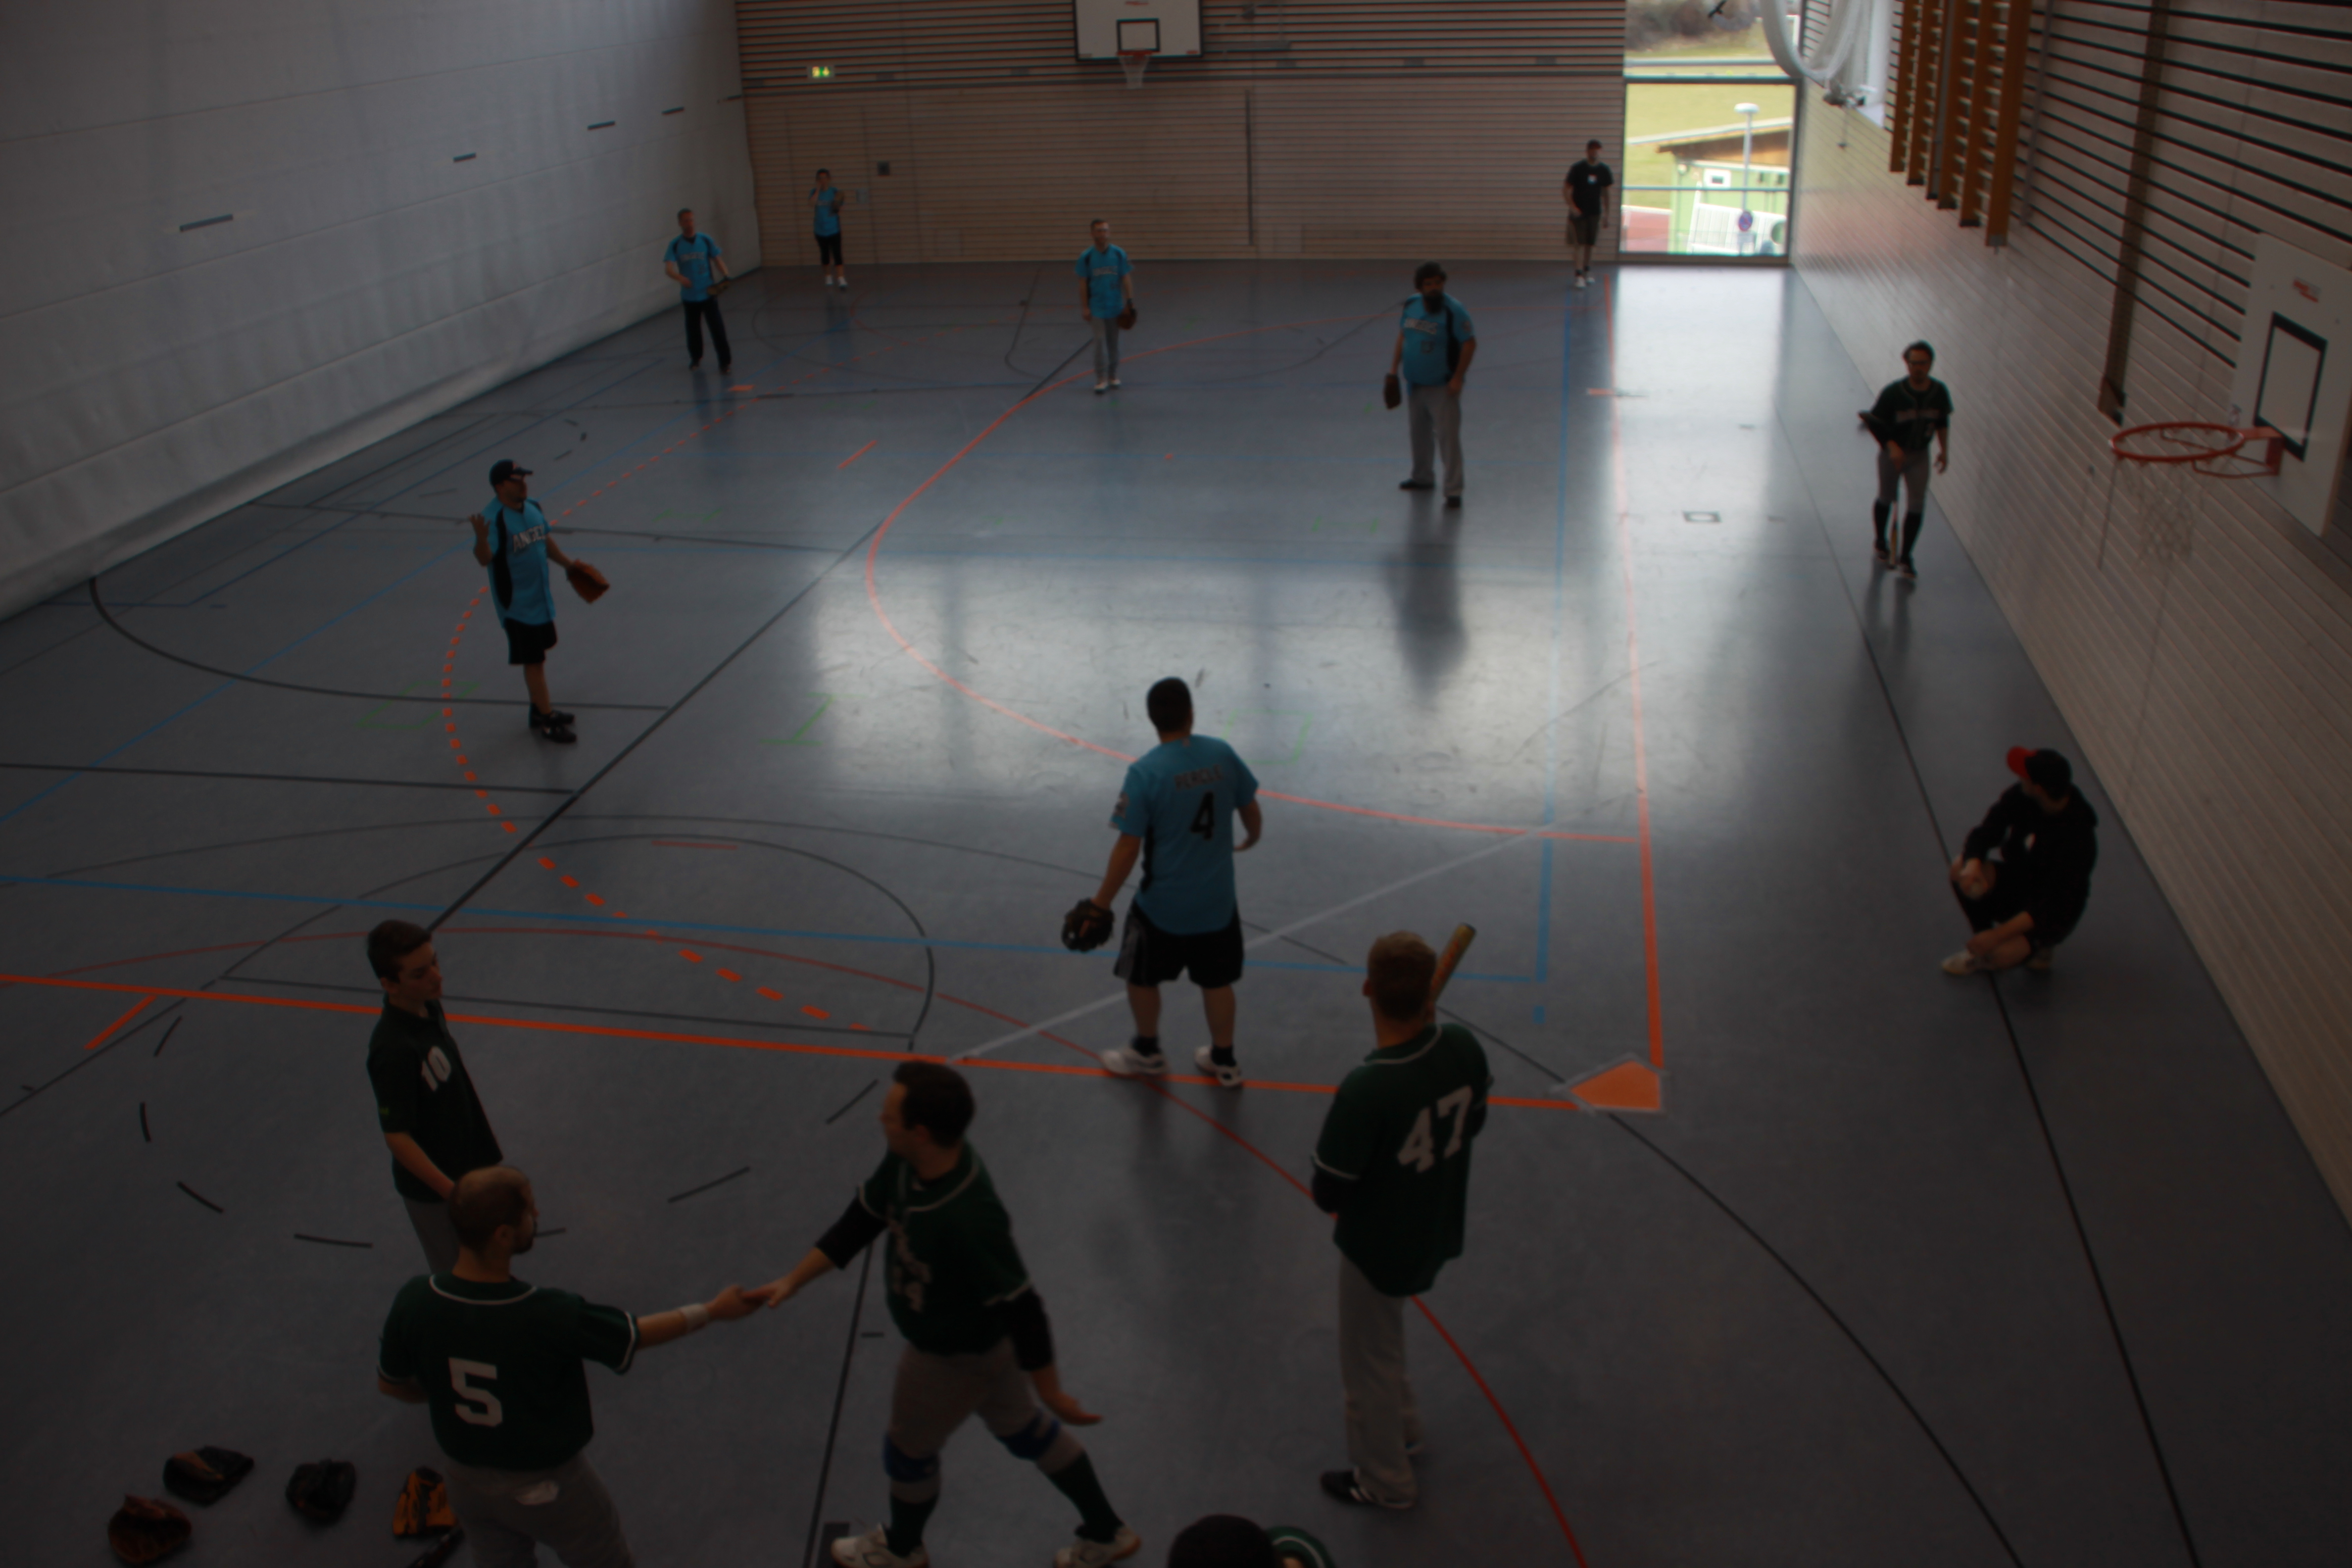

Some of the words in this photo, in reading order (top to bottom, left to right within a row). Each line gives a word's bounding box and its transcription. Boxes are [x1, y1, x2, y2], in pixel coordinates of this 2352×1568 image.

[1190, 790, 1215, 840] 4
[421, 1045, 451, 1092] 10
[1397, 1084, 1473, 1174] 47
[448, 1357, 503, 1427] 5
